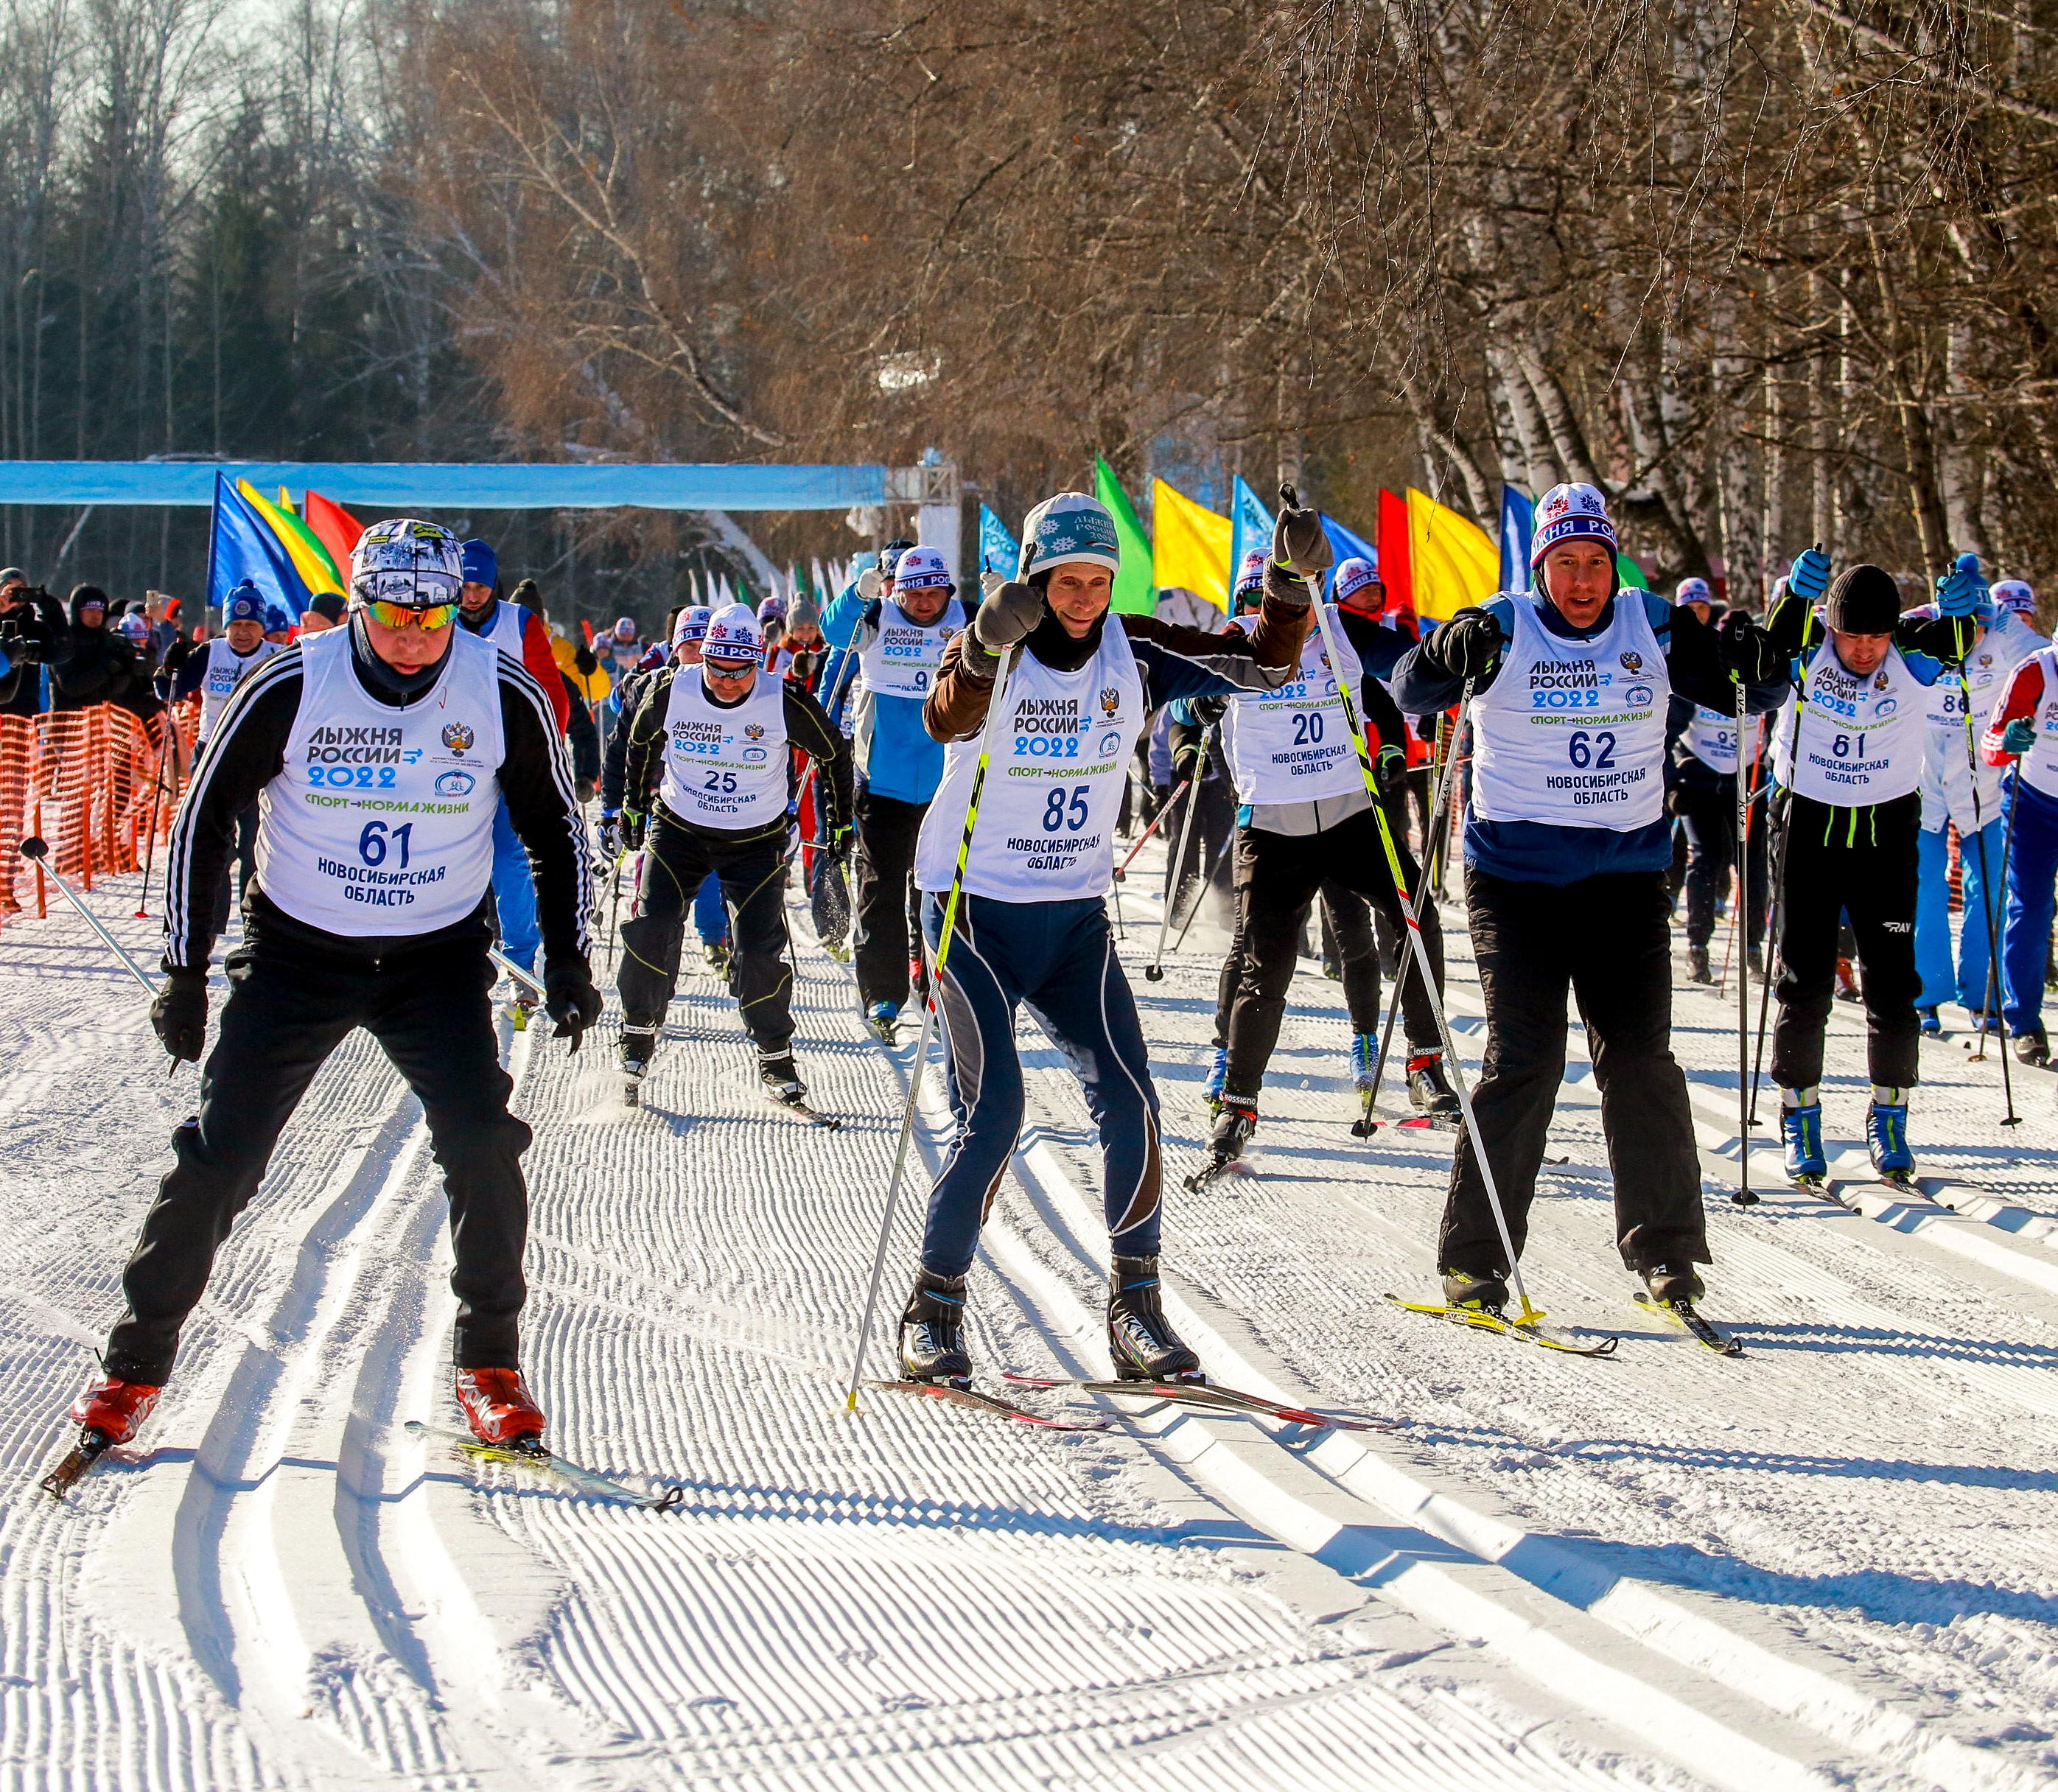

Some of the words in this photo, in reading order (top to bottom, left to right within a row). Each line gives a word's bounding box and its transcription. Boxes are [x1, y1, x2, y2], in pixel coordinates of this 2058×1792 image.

[884, 629, 923, 637] ЛЫЖНЯ
[884, 637, 923, 645] РОССИИ
[884, 646, 921, 657] 2022
[1529, 659, 1595, 674] ЛЫЖНЯ
[210, 682, 232, 692] 202
[1530, 673, 1598, 689] РОССИИ
[1014, 699, 1077, 715] ЛЫЖНЯ
[1259, 703, 1283, 711] СПОРТ
[1320, 698, 1342, 707] ЖИЗН
[1532, 690, 1599, 708] 2022
[1812, 690, 1856, 717] 2022
[672, 721, 722, 734] ЛЫЖНЯ
[1013, 717, 1078, 733] РОССИИ
[1530, 715, 1567, 724] СПОРТ
[308, 727, 402, 746] ЛЫЖНЯ
[673, 729, 721, 743] РОССИИ
[1292, 712, 1323, 746] 20
[674, 739, 720, 755] 2022
[1013, 736, 1079, 757] 2022
[1272, 744, 1346, 764] НОВОСИБИРСКАЯ
[1569, 730, 1617, 769] 62
[307, 746, 401, 764] РОССИИ
[1809, 752, 1889, 772] НОВОСИБИРСКАЯ
[1008, 766, 1043, 777] СПОРТ
[1291, 761, 1333, 776] ОБЛАСТЬ
[308, 766, 396, 788] 2022
[704, 770, 738, 794] 25
[1547, 767, 1646, 788] НОВОСИБИРСКАЯ
[1825, 771, 1869, 785] ОБЛАСТЬ
[305, 794, 349, 809] СПОРТ
[1574, 788, 1628, 805] ОБЛАСТЬ
[698, 800, 738, 813] ОБЛАСТЬ
[1043, 785, 1090, 832] 85
[359, 820, 413, 869] 61
[1007, 833, 1101, 853] НОВОСИБИРСКАЯ
[318, 857, 446, 885] НОВОСИБИРСКАЯ
[1027, 856, 1077, 870] ОБЛАСТЬ
[344, 885, 415, 906] ОБЛАСТЬ
[1883, 922, 1911, 933] RAY
